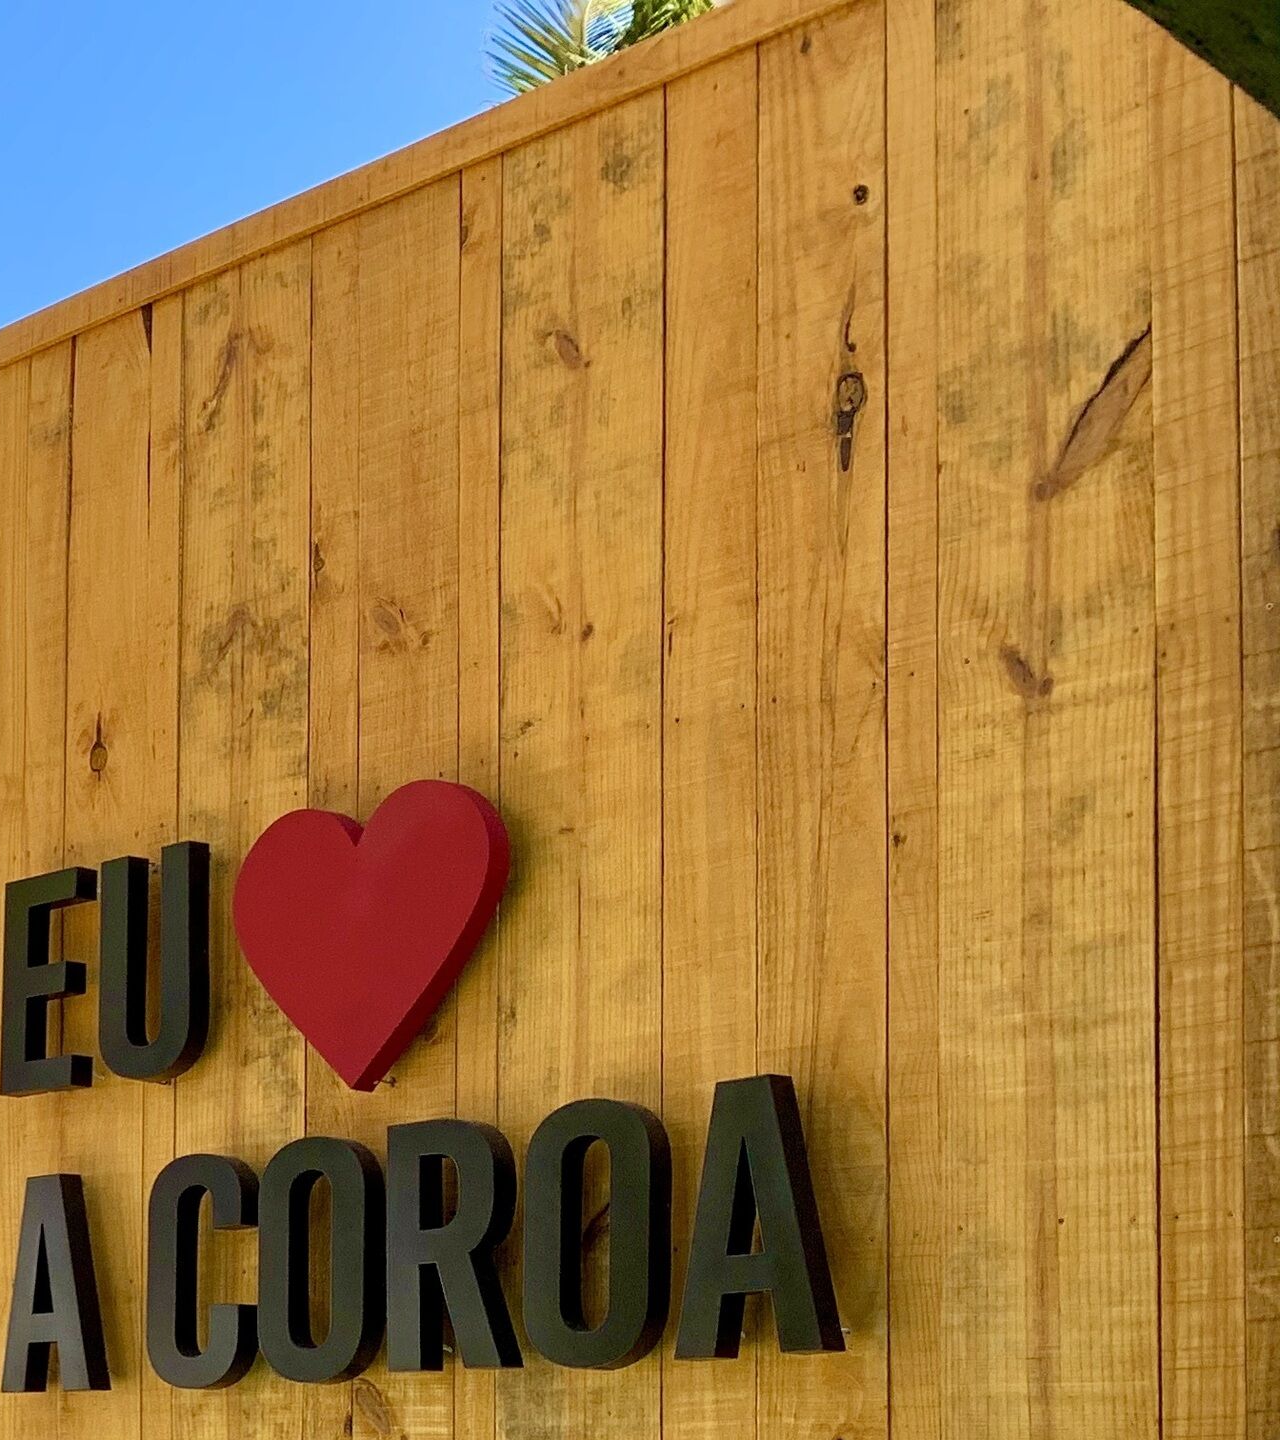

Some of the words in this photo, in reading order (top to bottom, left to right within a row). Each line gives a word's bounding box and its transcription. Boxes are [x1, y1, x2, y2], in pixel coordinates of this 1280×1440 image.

[0, 841, 210, 1096] EU
[1, 1173, 111, 1393] A
[146, 1073, 846, 1390] COROA
